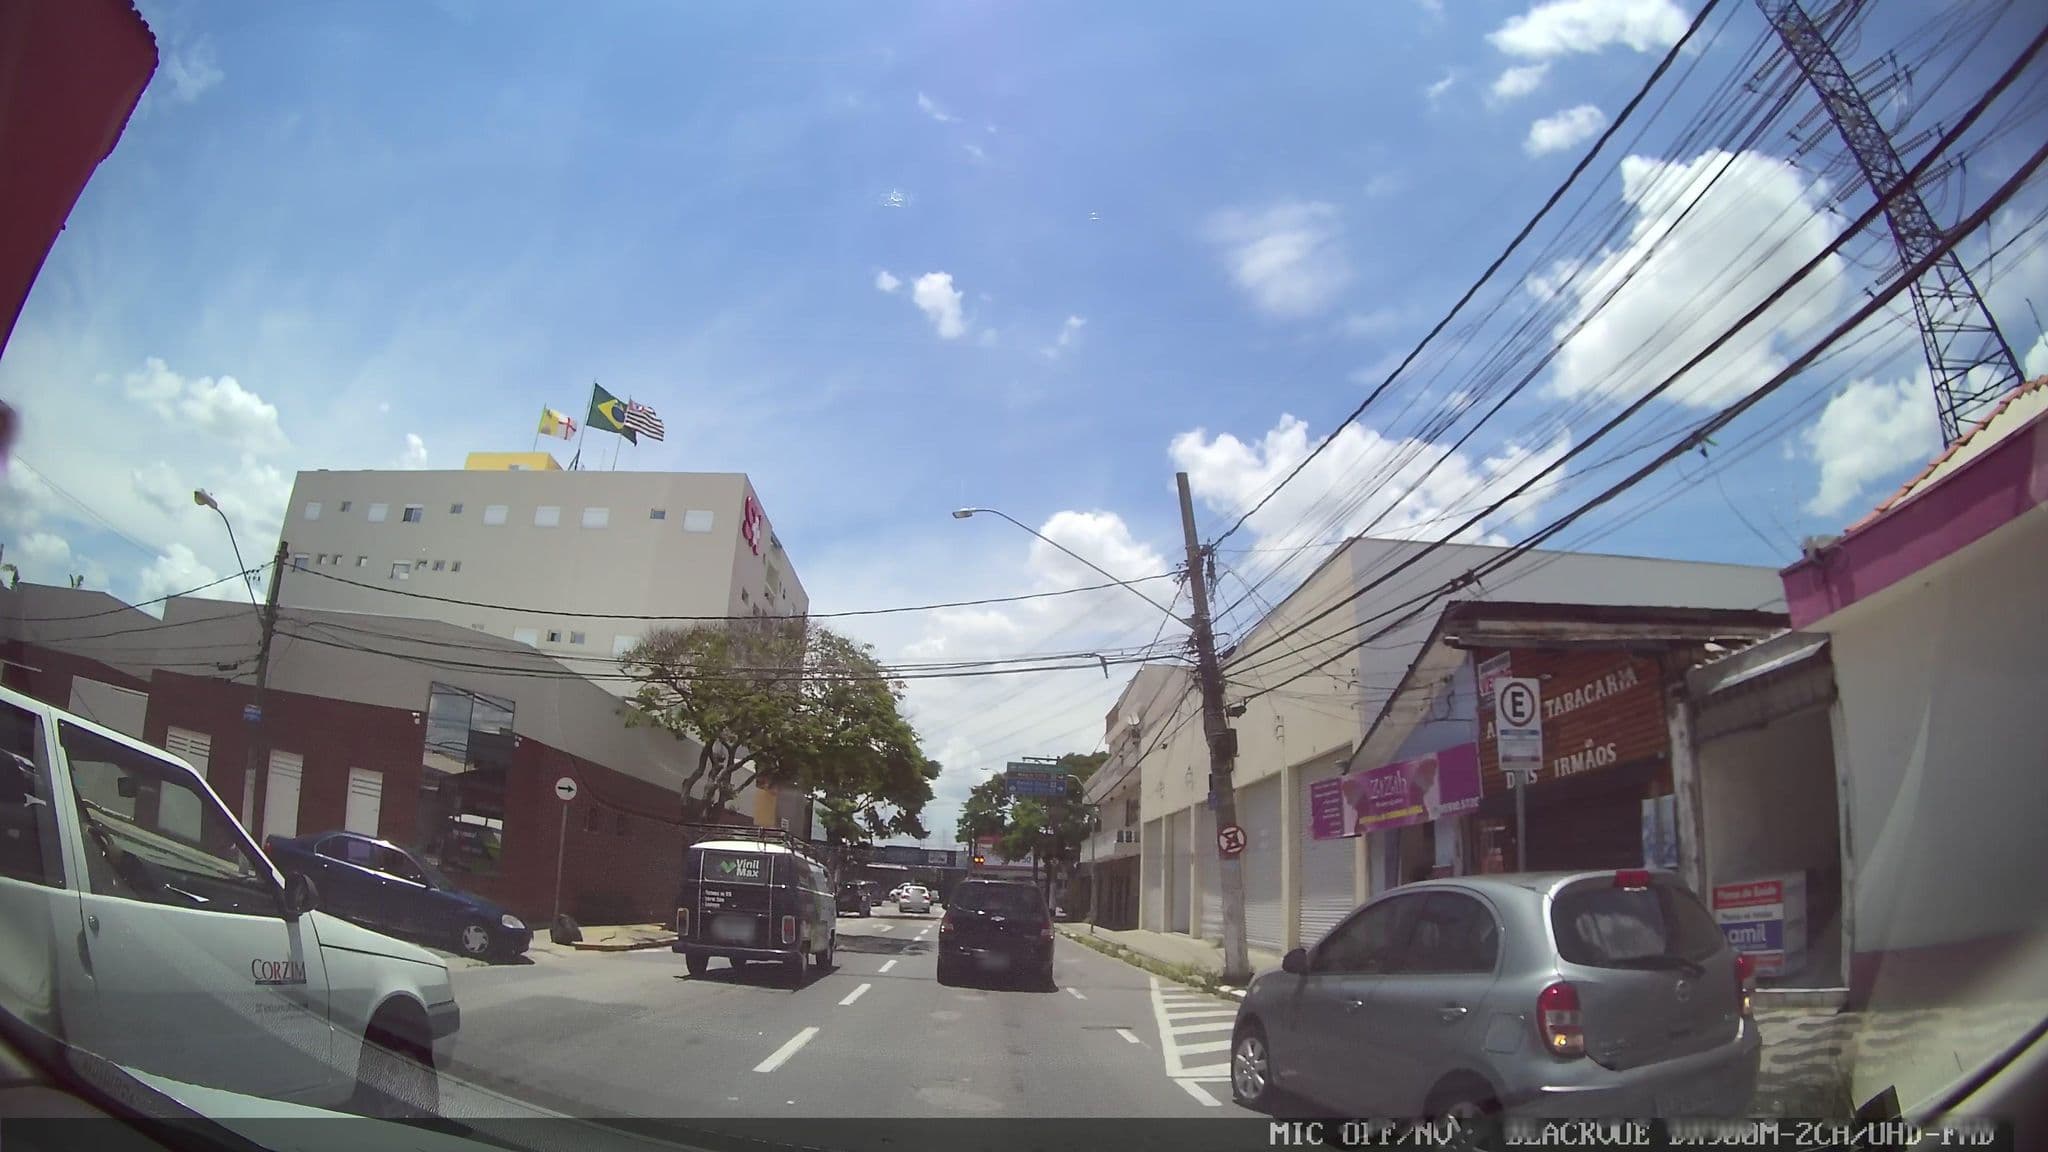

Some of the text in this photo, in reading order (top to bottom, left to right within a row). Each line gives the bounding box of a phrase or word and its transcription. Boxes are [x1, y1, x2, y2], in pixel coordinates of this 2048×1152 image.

[1544, 665, 1639, 718] TABACARIA
[1512, 692, 1525, 717] E
[1506, 768, 1538, 790] DIS
[1553, 738, 1617, 778] IRMÃOS
[736, 859, 760, 869] Vinil
[736, 867, 759, 877] Max
[1728, 923, 1767, 945] amil
